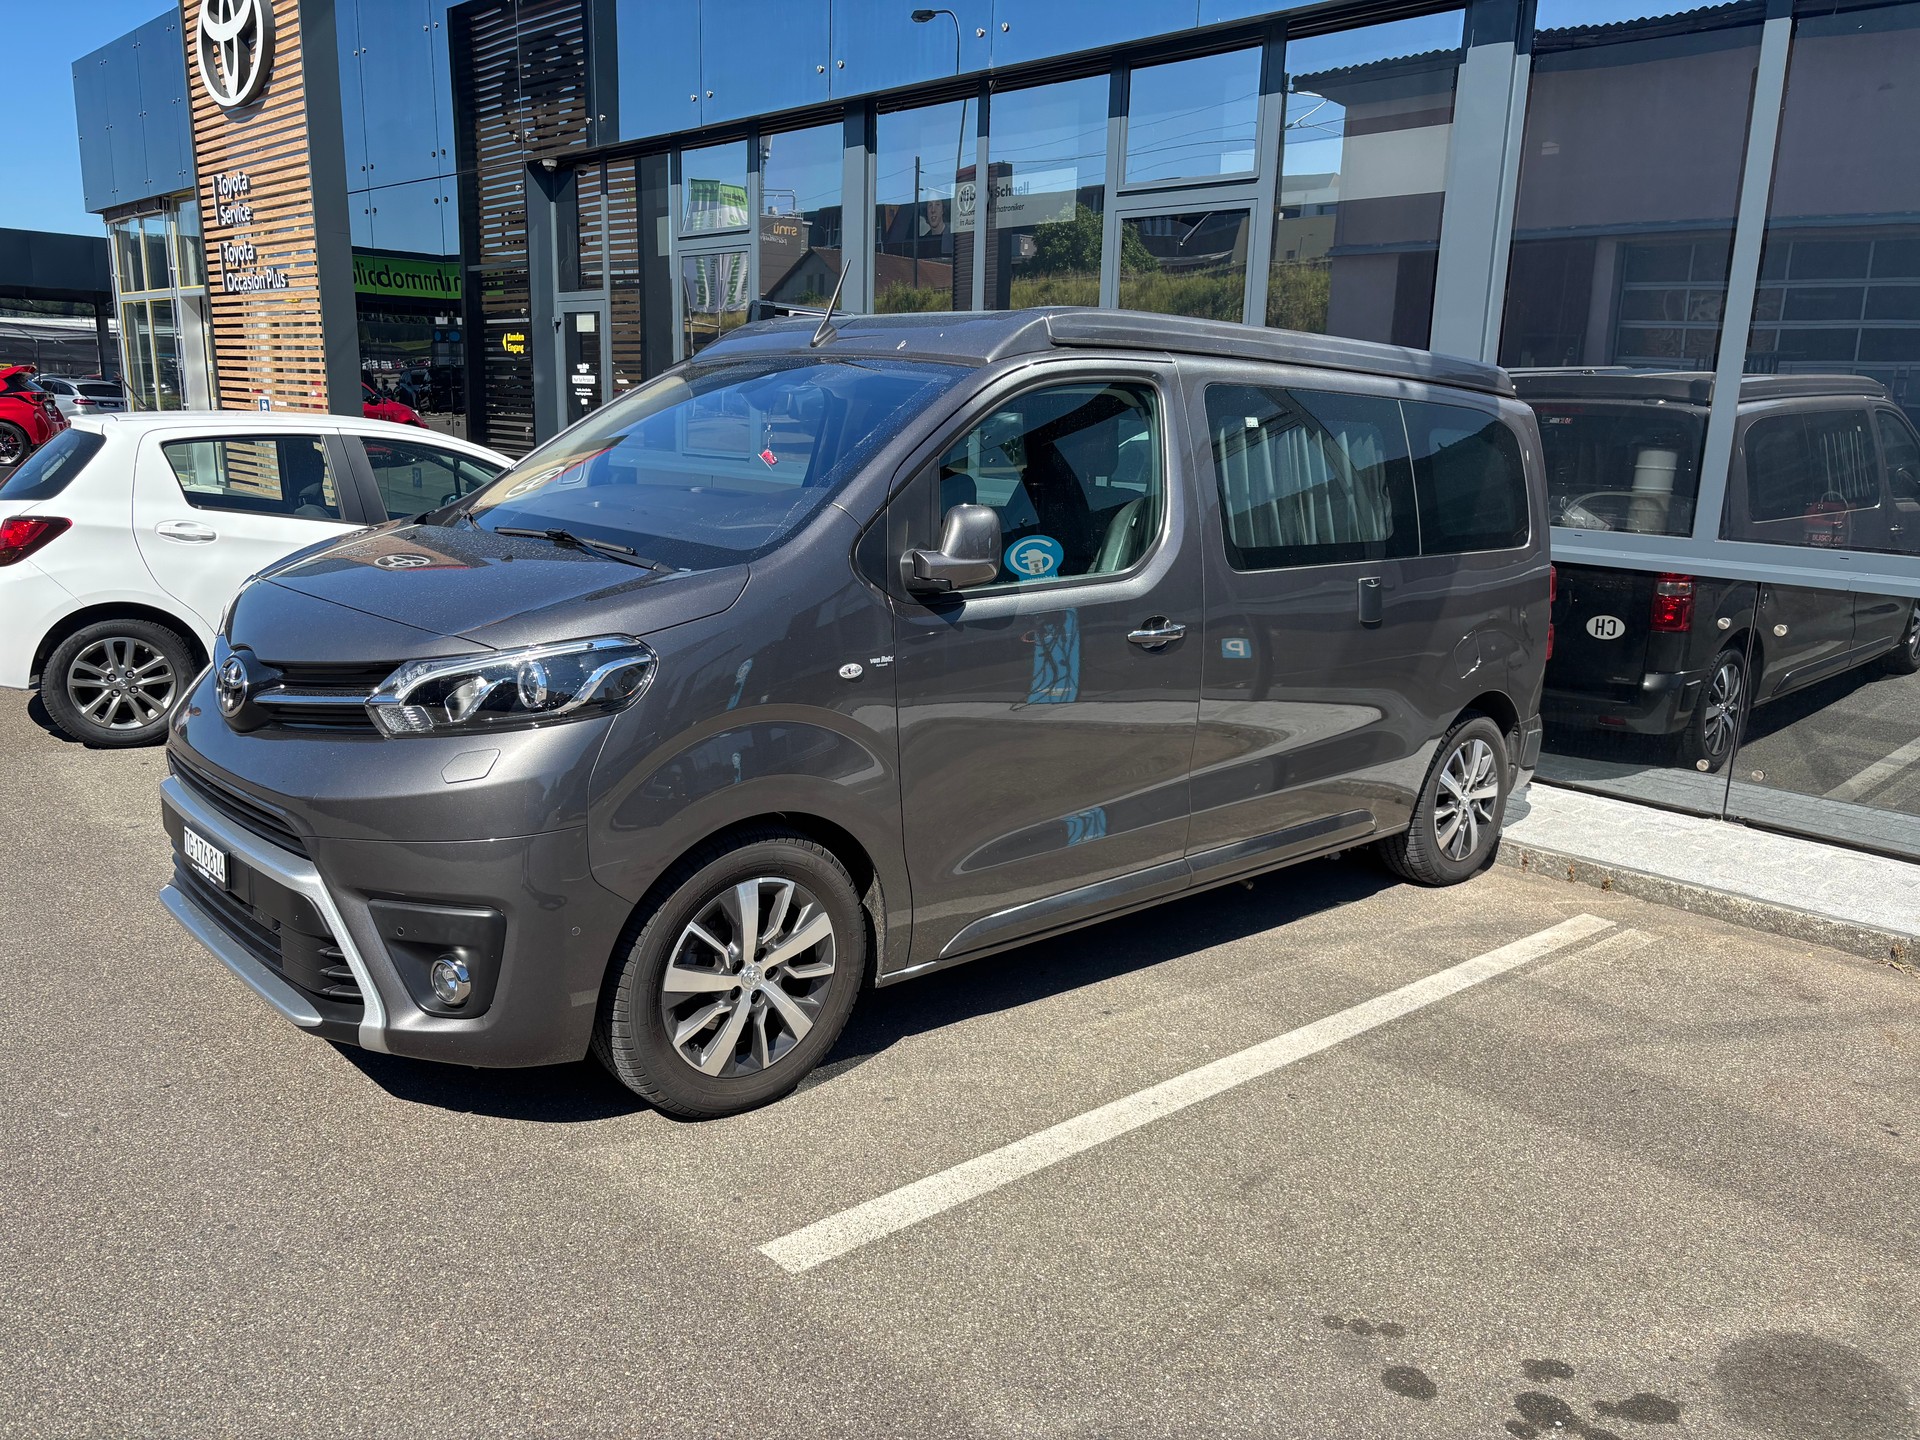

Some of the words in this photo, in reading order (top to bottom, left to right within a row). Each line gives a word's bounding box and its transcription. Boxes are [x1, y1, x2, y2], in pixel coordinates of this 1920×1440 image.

[217, 171, 248, 198] Toyota
[994, 181, 1029, 198] Schnell
[220, 203, 251, 225] Service
[224, 241, 254, 267] Toyota
[226, 271, 266, 292] Occasion
[266, 267, 286, 289] Plus
[508, 343, 524, 354] Eingang
